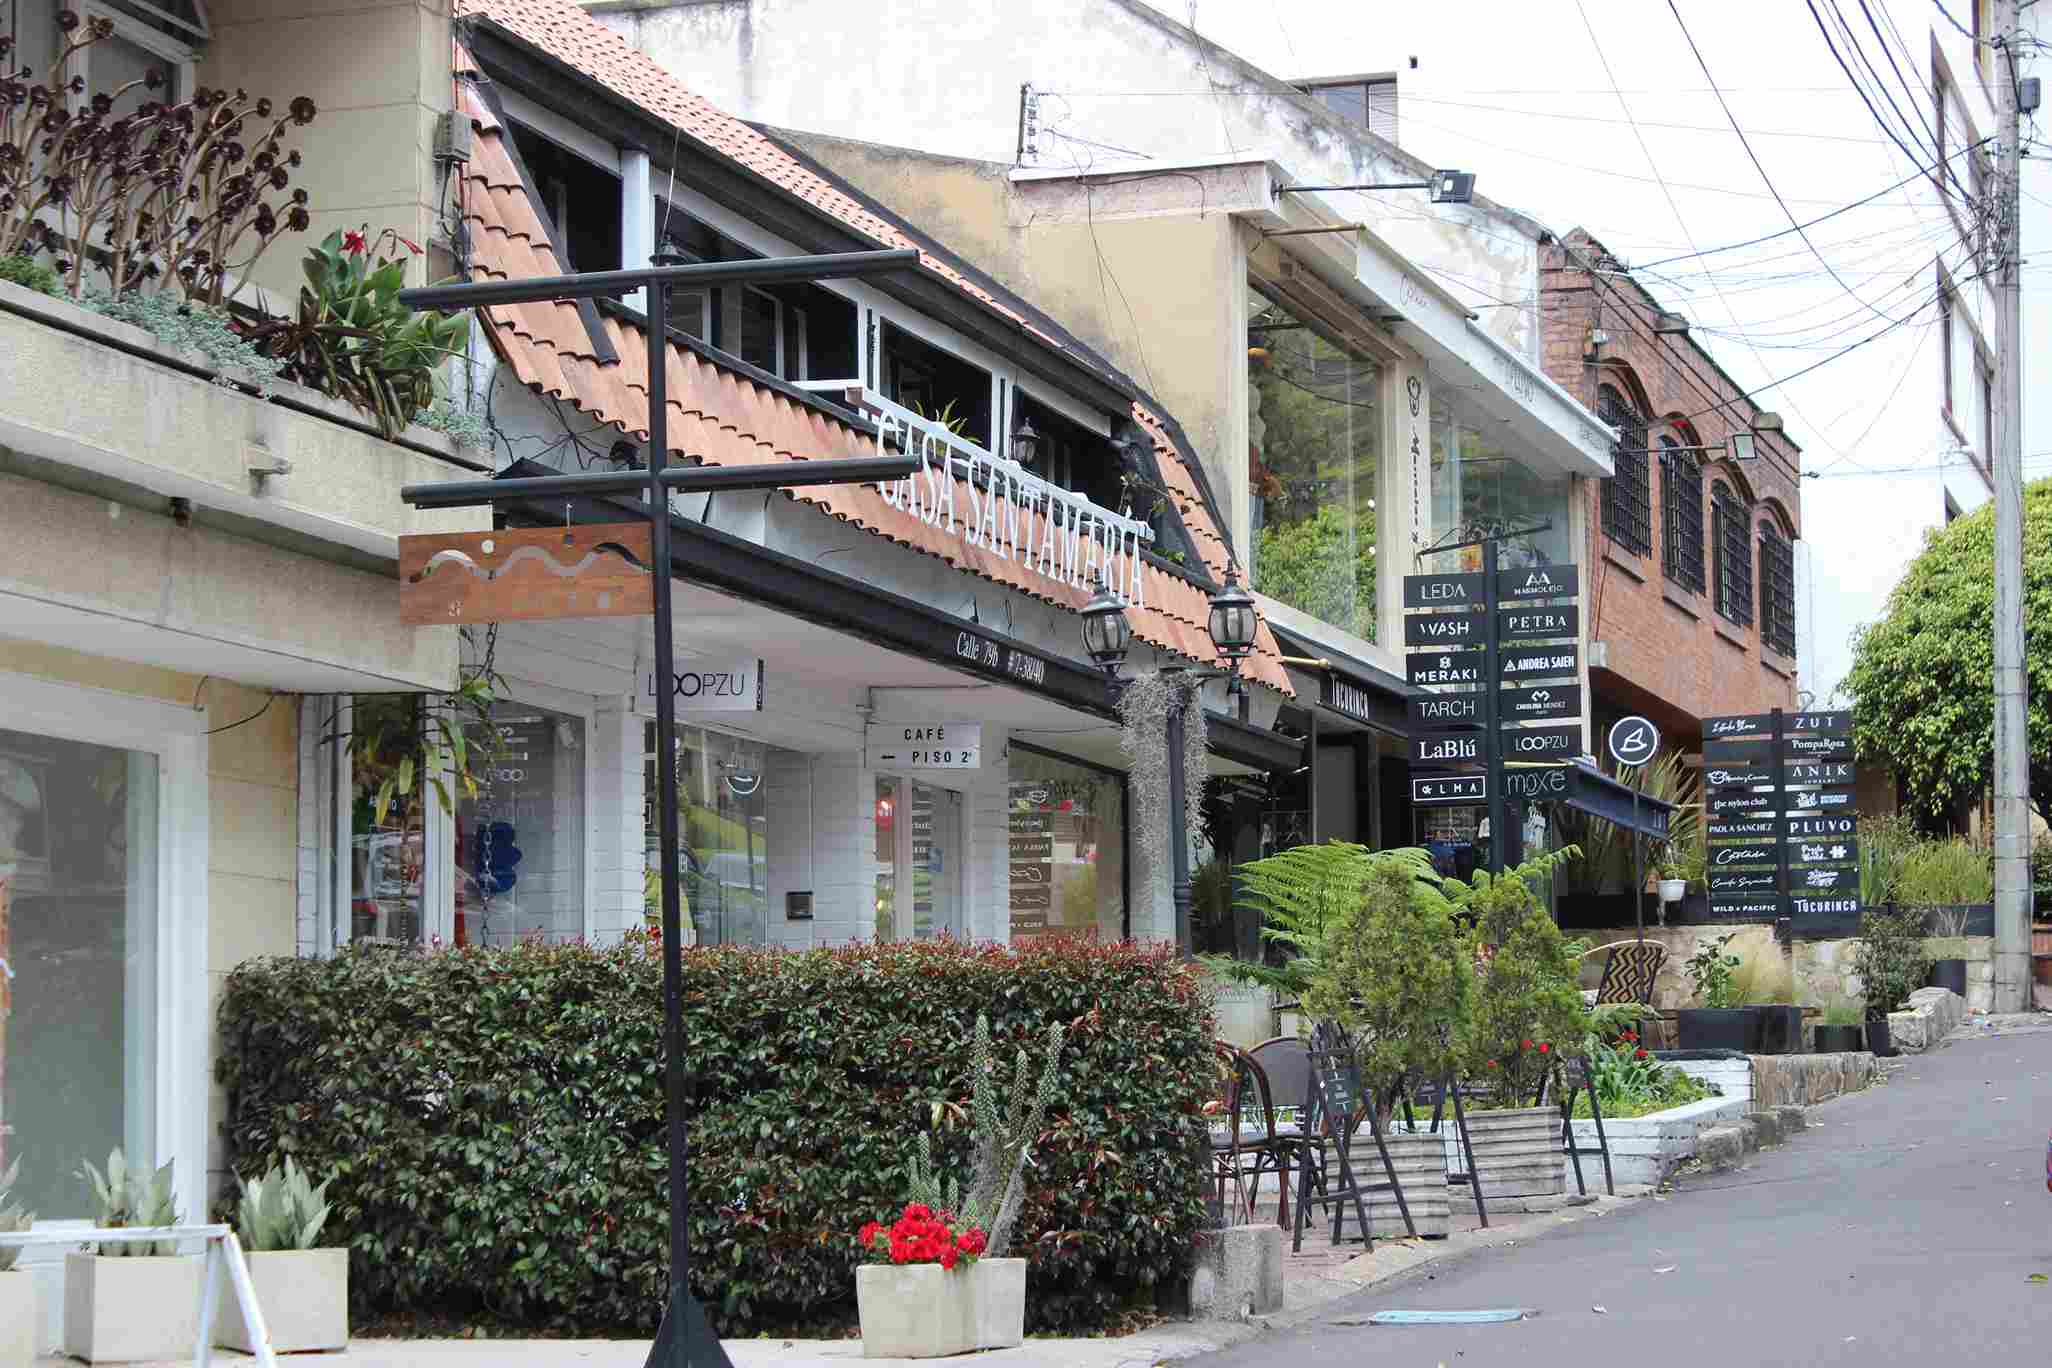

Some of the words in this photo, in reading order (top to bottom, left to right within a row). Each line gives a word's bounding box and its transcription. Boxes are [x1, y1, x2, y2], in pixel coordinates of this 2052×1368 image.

[1421, 583, 1466, 600] LEDA
[1420, 622, 1470, 636] WASH
[1509, 615, 1568, 629] PETRA
[1517, 658, 1550, 672] ANDREA
[1415, 669, 1478, 682] MERAKI
[1418, 701, 1476, 718] TARCH
[1795, 717, 1835, 729] ZUT
[904, 725, 945, 741] CAFÉ
[1419, 738, 1477, 759] LaBlú
[1515, 735, 1569, 752] LOOPZU
[912, 751, 952, 763] PISO
[1714, 800, 1727, 809] the
[1750, 798, 1768, 807] club
[1709, 823, 1735, 832] PAOLA
[1790, 820, 1851, 833] PLUVO
